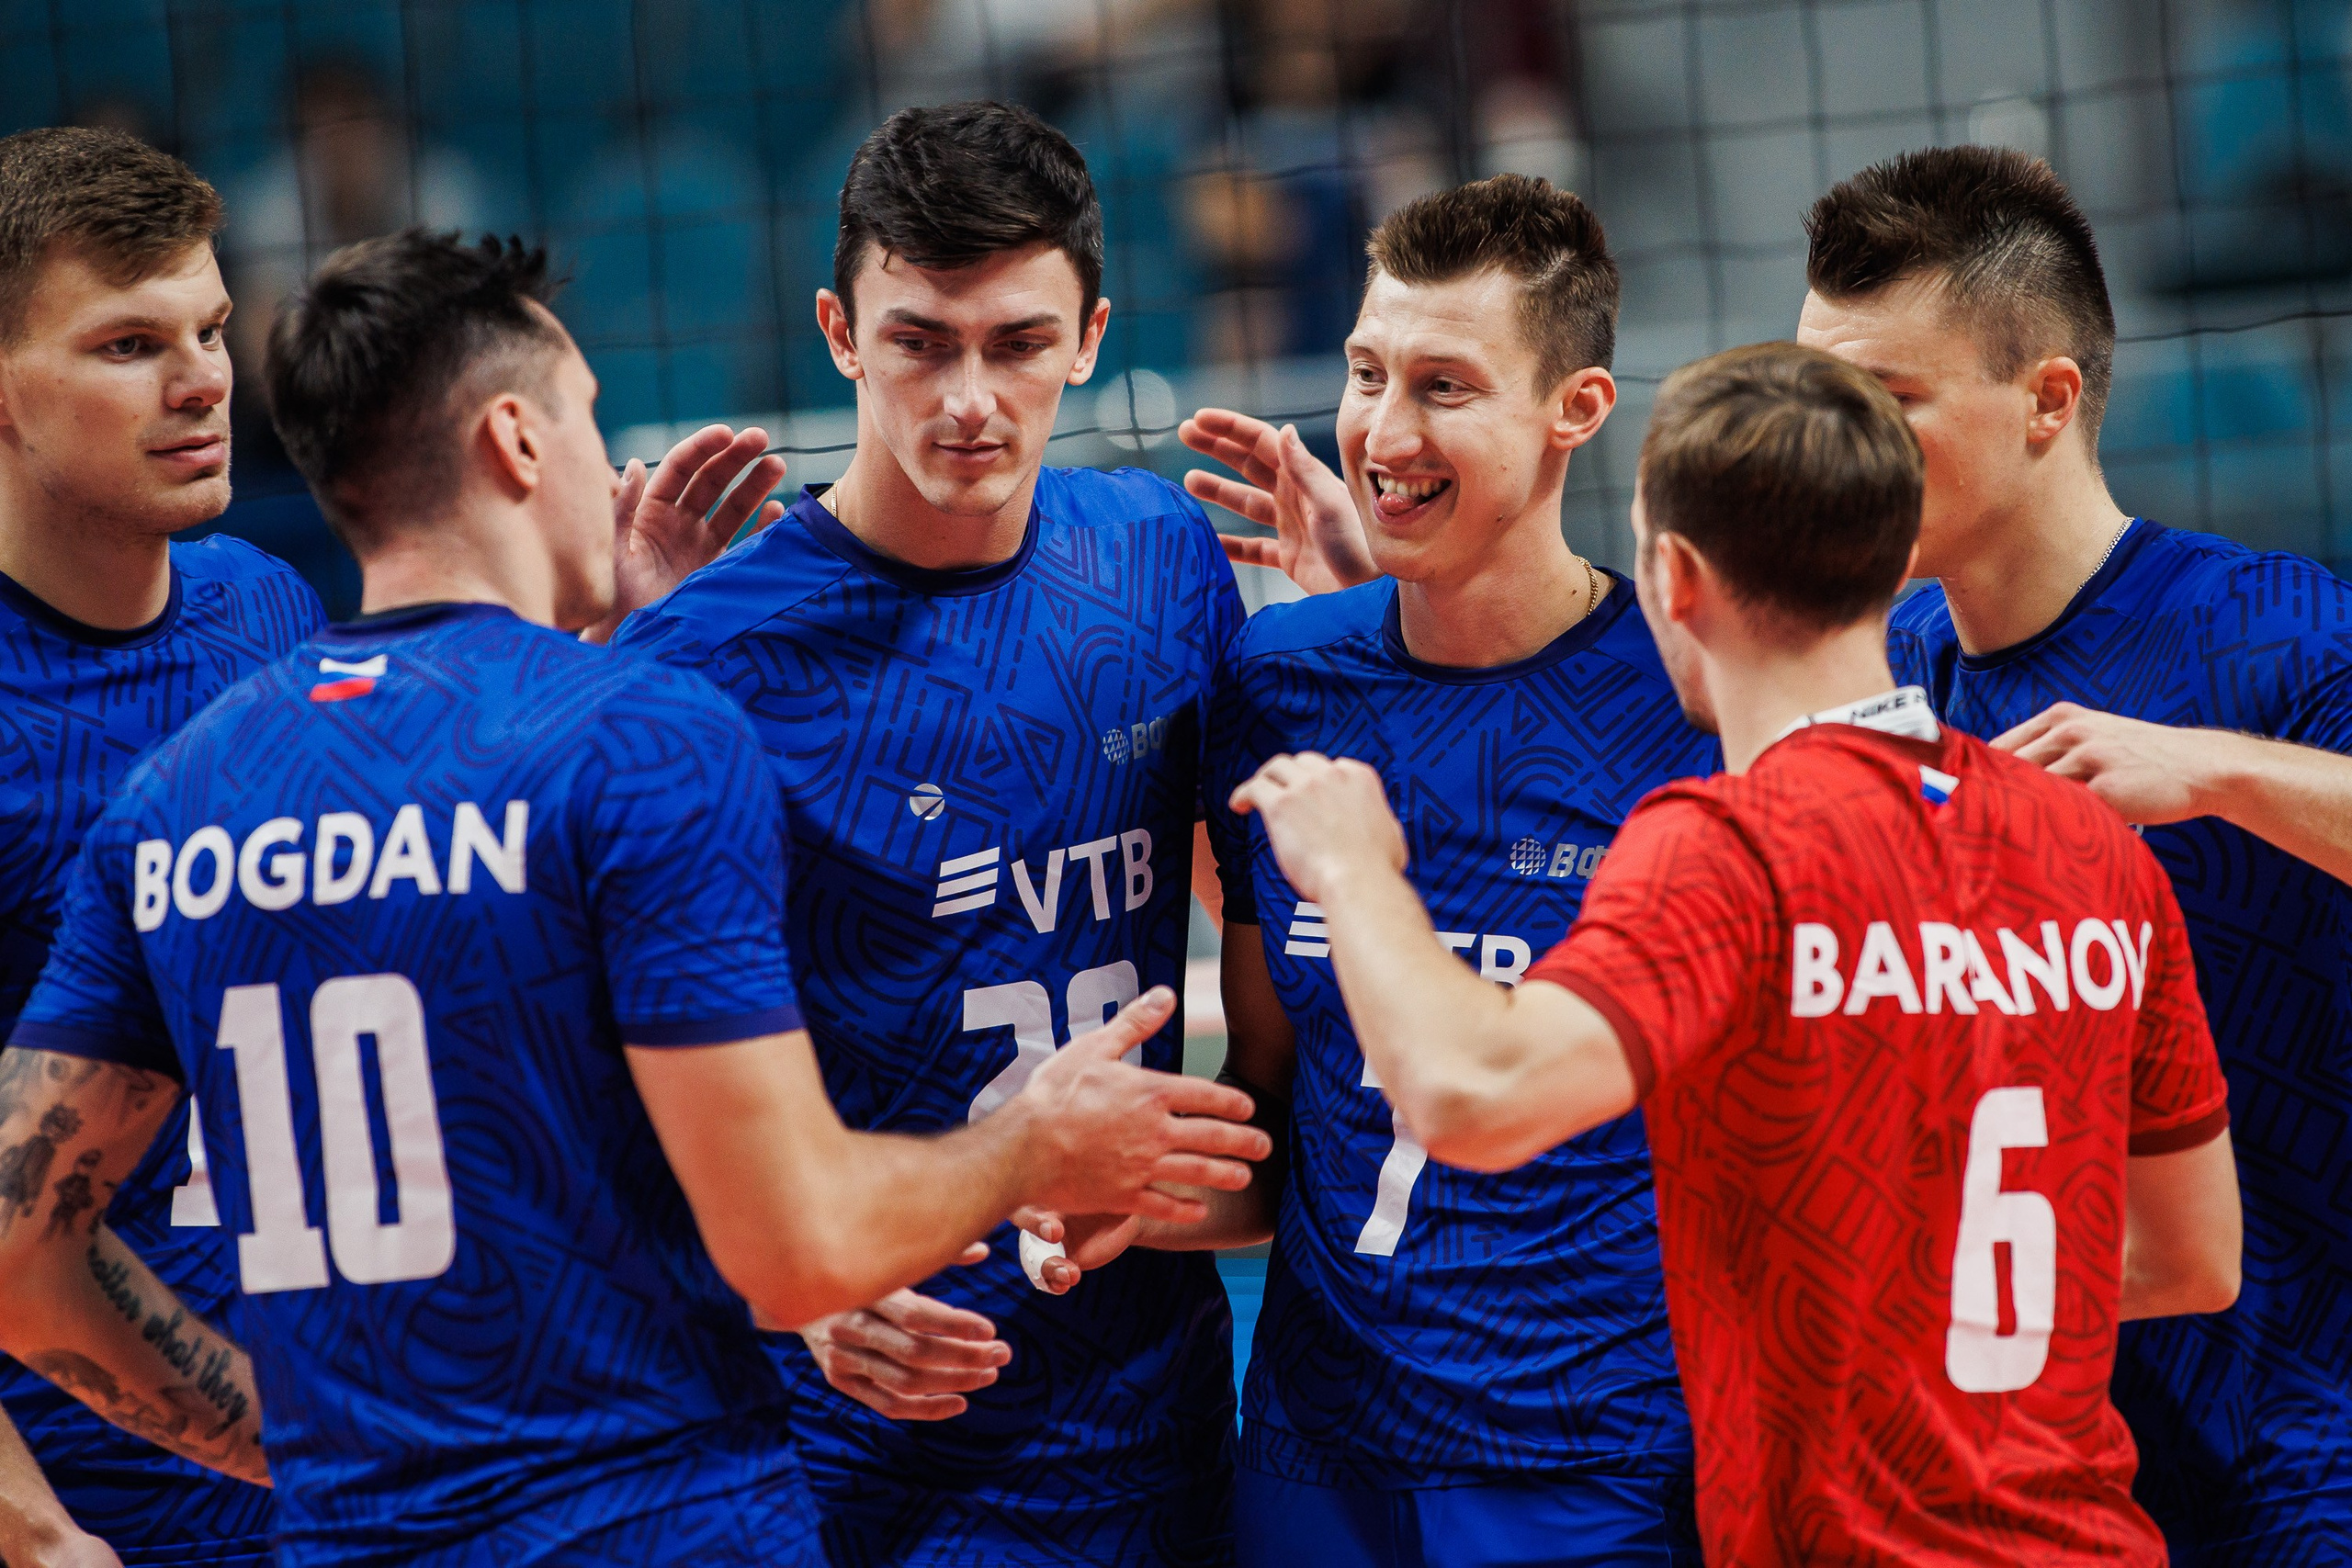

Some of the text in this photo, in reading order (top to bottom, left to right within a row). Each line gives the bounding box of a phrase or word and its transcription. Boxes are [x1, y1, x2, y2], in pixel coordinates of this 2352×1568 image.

[1131, 715, 1173, 760] ВФ
[132, 799, 529, 932] BOGDAN
[1011, 828, 1153, 934] VTB
[1547, 843, 1610, 879] ВФ
[1791, 918, 2153, 1017] BARANOV
[216, 972, 457, 1294] 10
[1945, 1087, 2056, 1393] 6
